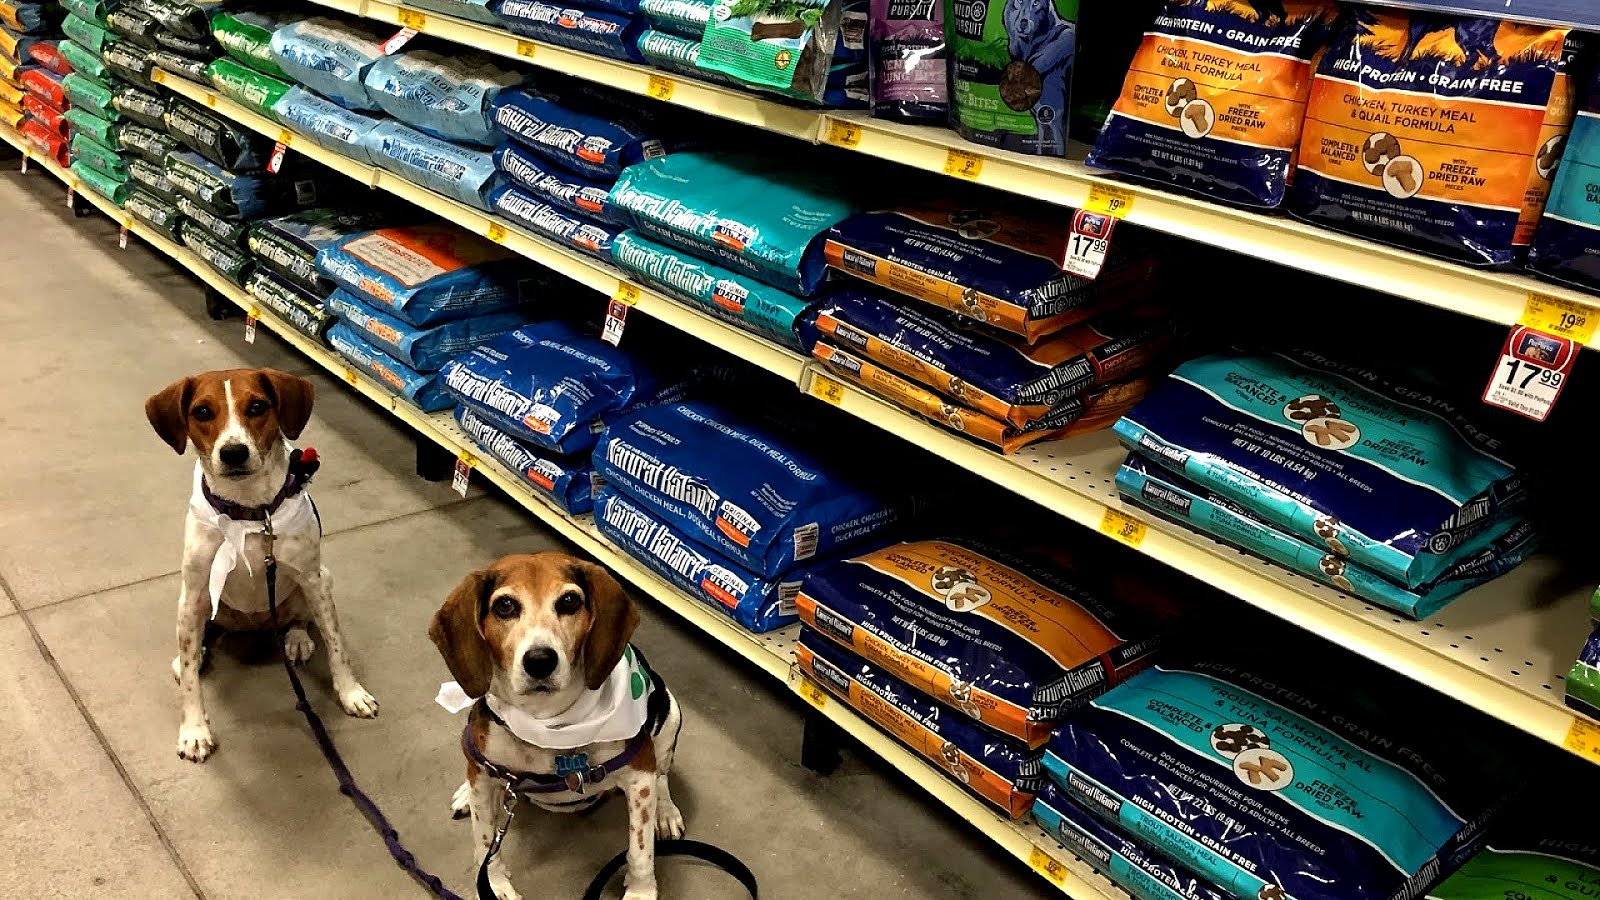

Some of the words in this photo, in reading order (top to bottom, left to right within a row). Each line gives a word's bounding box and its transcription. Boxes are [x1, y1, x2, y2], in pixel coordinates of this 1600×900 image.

[891, 4, 931, 16] PURSUIT
[955, 3, 971, 17] WILD
[1174, 16, 1214, 35] PROTEIN
[1226, 29, 1269, 47] GRAIN
[1269, 36, 1301, 49] FREE
[1167, 59, 1192, 71] QUAIL
[1194, 64, 1243, 81] FORMULA
[1192, 51, 1233, 68] TURKEY
[1235, 62, 1261, 72] MEAL
[1333, 58, 1360, 72] HIGH
[1360, 66, 1416, 84] PROTEIN
[1428, 75, 1476, 90] GRAIN
[1479, 78, 1524, 94] FREE
[969, 93, 997, 109] BITES
[1228, 107, 1260, 119] FREEZE
[1391, 103, 1437, 118] TURKEY
[1440, 110, 1476, 123] MEAL
[1218, 113, 1244, 125] DRIED
[1244, 119, 1265, 130] RAW
[1350, 110, 1357, 118] &
[1359, 111, 1392, 126] QUAIL
[1394, 116, 1456, 134] FORMULA
[1320, 137, 1355, 153] COMPLETE
[1320, 146, 1356, 162] BALANCED
[1428, 171, 1459, 185] DRIED
[1460, 176, 1486, 187] RAW
[1440, 164, 1478, 176] FREEZE
[619, 238, 663, 278] Natural
[660, 255, 715, 298] Balance
[901, 259, 924, 271] PROTEIN
[927, 268, 944, 278] GRAIN
[944, 274, 959, 283] FREE
[914, 350, 932, 362] GRAIN
[932, 359, 946, 370] FREE
[1104, 341, 1122, 355] HIGH
[1056, 358, 1091, 386] Balance
[1224, 376, 1277, 407] BALANCED
[1226, 371, 1278, 399] COMPLETE
[1278, 395, 1287, 403] &
[1340, 394, 1408, 427] FORMULA
[749, 438, 768, 454] DUCK
[767, 448, 788, 466] MEAL
[1232, 438, 1248, 450] NET
[1249, 445, 1262, 455] WT
[1270, 453, 1283, 465] LBS
[1361, 440, 1403, 459] DRIED
[1401, 453, 1429, 467] RAW
[1379, 439, 1423, 457] FREEZE
[606, 438, 665, 489] Natural
[660, 465, 720, 520] Balance
[1228, 479, 1258, 499] FORMULA
[1265, 477, 1290, 495] GRAIN
[634, 484, 662, 505] CHICKEN
[723, 512, 747, 535] ULTRA
[724, 504, 757, 530] ORIGINAL
[602, 495, 658, 546] Natural
[649, 524, 709, 583] Balance
[835, 532, 853, 543] DUCK
[853, 526, 870, 538] MEAL
[710, 574, 737, 597] ULTRA
[712, 565, 744, 591] ORIGINAL
[982, 572, 1038, 605] FORMULA
[1029, 589, 1062, 608] MEAL
[861, 620, 879, 634] HIGH
[879, 630, 908, 652] PROTEIN
[911, 648, 934, 663] GRAIN
[934, 659, 953, 673] FREE
[1121, 645, 1142, 659] HIGH
[911, 659, 927, 672] MEAL
[856, 674, 872, 686] HIGH
[902, 704, 923, 721] GRAIN
[922, 717, 940, 732] FREE
[1149, 698, 1206, 728] COMPLETE
[1204, 722, 1213, 730] &
[1239, 671, 1319, 711] PROTEIN
[1332, 714, 1393, 749] GRAIN
[904, 719, 919, 731] MEAL
[1146, 704, 1205, 734] BALANCED
[1214, 699, 1225, 707] &
[1228, 702, 1269, 728] TUNA
[1272, 725, 1348, 772] FORMULA
[1263, 707, 1329, 745] SALMON
[1330, 744, 1374, 774] MEAL
[1120, 739, 1152, 761] COMPLETE
[1158, 760, 1192, 784] BALANCED
[1208, 787, 1237, 808] PUPPIES
[1238, 803, 1249, 812] TO
[1248, 808, 1275, 827] ADULTS
[1279, 827, 1295, 839] ALL
[1295, 835, 1326, 855] BREEDS
[1160, 751, 1175, 764] DOG
[1176, 760, 1195, 775] FOOD
[1200, 772, 1243, 801] NOURRITURE
[1243, 796, 1263, 810] POUR
[1264, 806, 1290, 825] CHIENS
[1167, 783, 1183, 797] NET
[1311, 779, 1358, 806] FREEZE
[1294, 781, 1333, 804] DRIED
[1333, 797, 1367, 820] RAW
[1132, 794, 1155, 812] HIGH
[1155, 808, 1195, 836] PROTEIN
[1200, 835, 1231, 857] GRAIN
[1231, 853, 1258, 871] FREE
[1455, 821, 1477, 843] HIGH
[1120, 847, 1143, 865] HIGH
[1163, 838, 1199, 863] FORMULA
[1165, 829, 1197, 851] SALMON
[1196, 851, 1217, 866] MEAL
